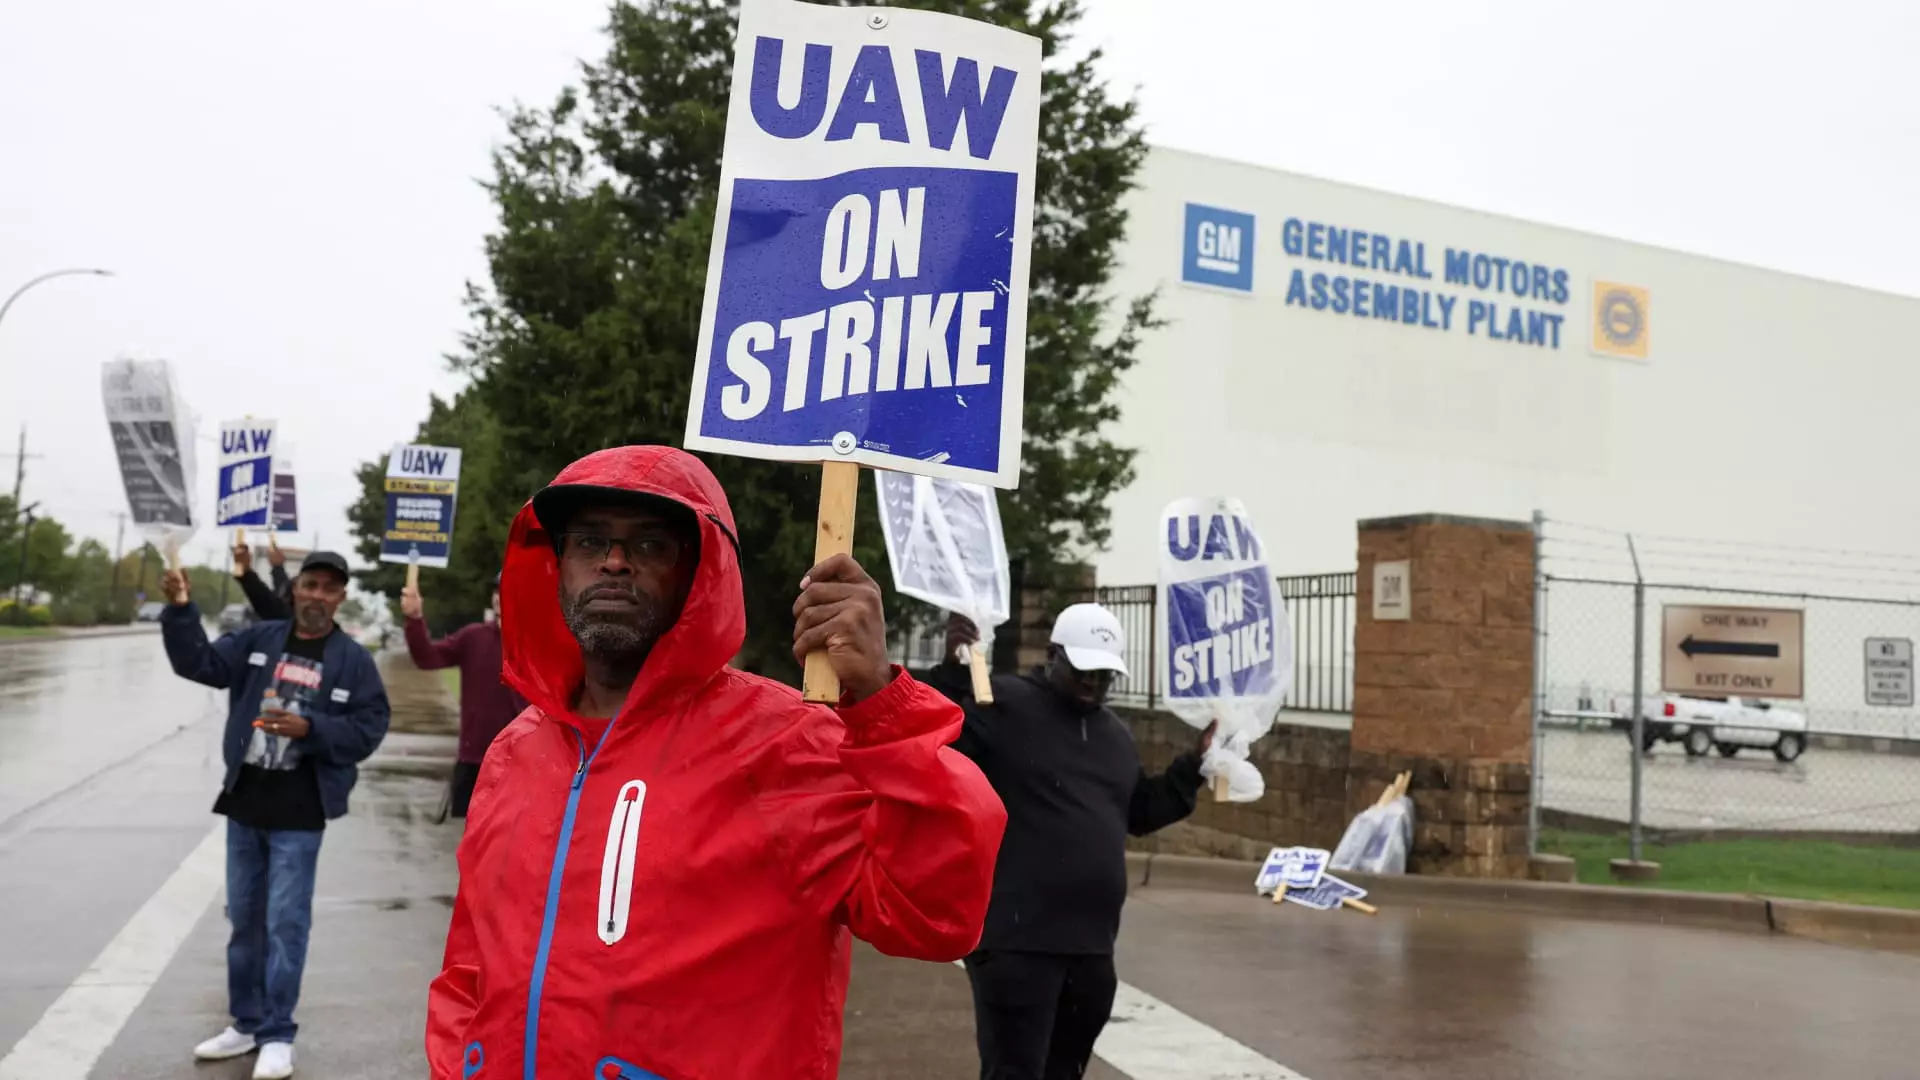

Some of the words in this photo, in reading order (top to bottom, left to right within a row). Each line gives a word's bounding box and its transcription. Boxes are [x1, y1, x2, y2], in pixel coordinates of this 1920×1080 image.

[749, 35, 1018, 160] UAW
[820, 186, 925, 290] ON
[1196, 220, 1241, 262] GM
[1282, 217, 1432, 280] GENERAL
[1443, 247, 1569, 304] MOTORS
[1285, 268, 1457, 331] ASSEMBLY
[1467, 301, 1565, 349] PLANT
[720, 290, 994, 421] STRIKE
[222, 428, 272, 454] UAW
[401, 448, 448, 476] UAW
[1168, 514, 1260, 562] UAW
[1206, 579, 1244, 631] ON
[1702, 613, 1731, 628] ONE
[1736, 615, 1769, 629] WAY
[1174, 618, 1271, 691] STRIKE
[1695, 673, 1729, 687] EXIT
[1731, 674, 1774, 689] ONLY
